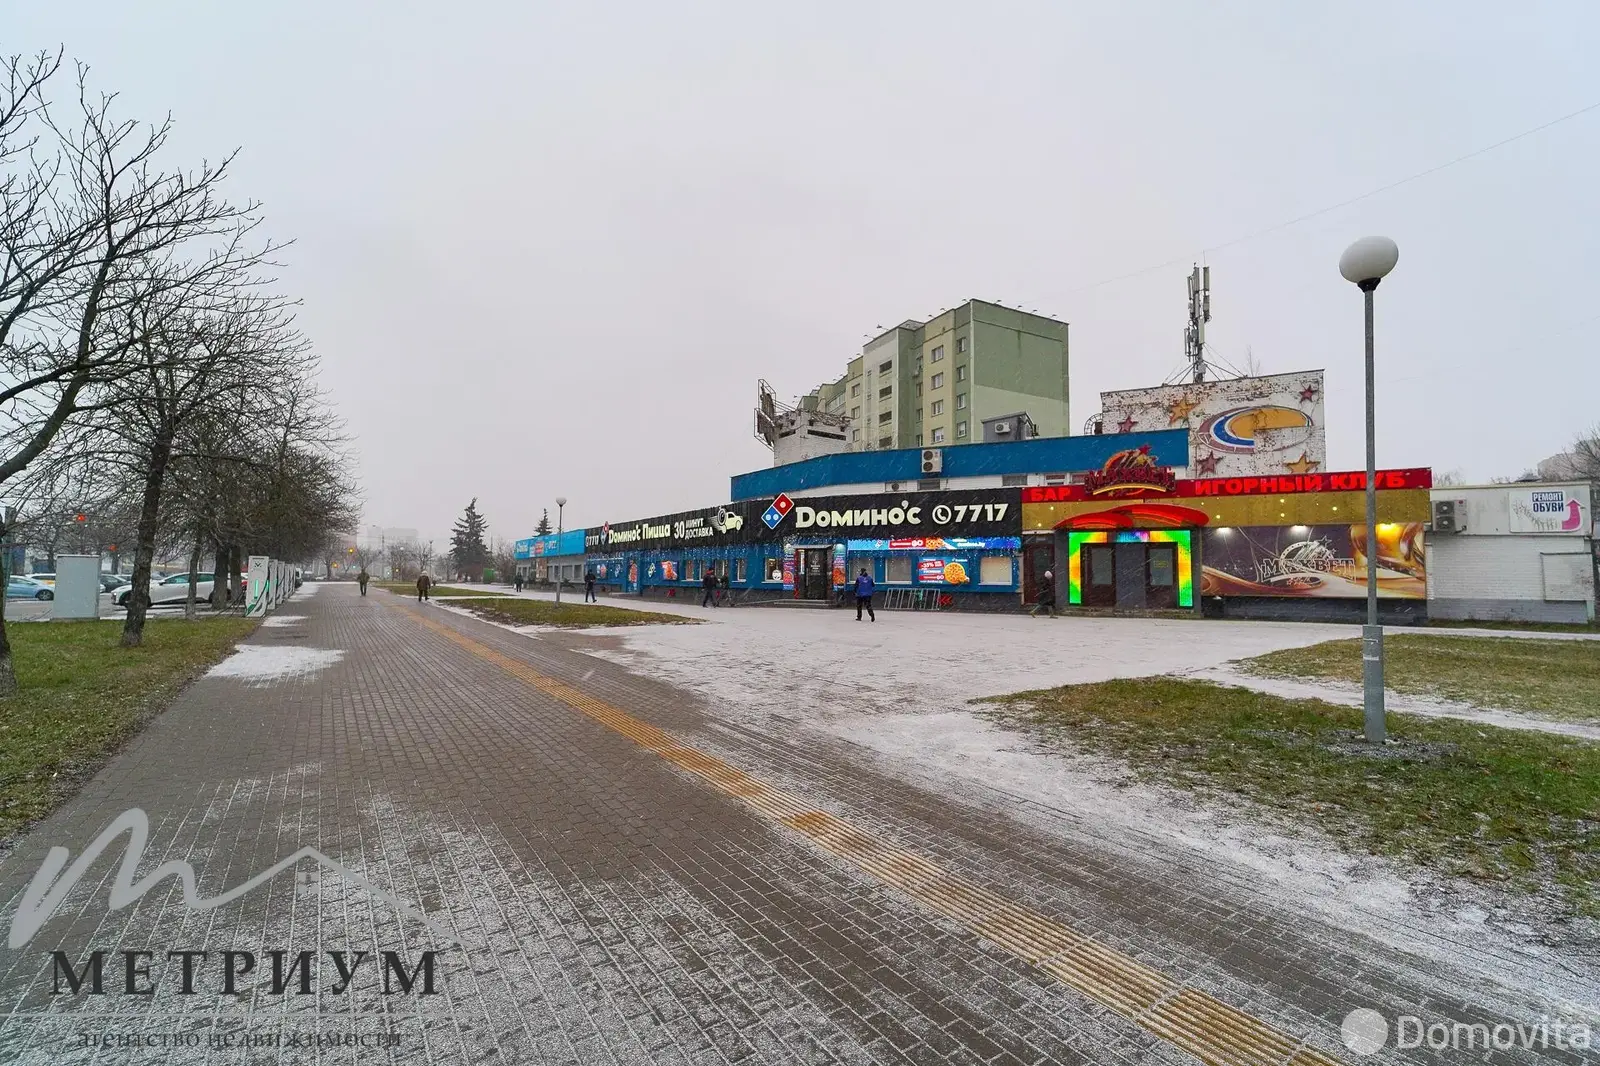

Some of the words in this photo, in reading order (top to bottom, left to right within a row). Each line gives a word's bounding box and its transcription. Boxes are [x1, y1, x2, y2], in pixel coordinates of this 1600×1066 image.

[1195, 474, 1322, 496] ИГОРНЫЙ
[1330, 471, 1406, 490] КЛУБ
[1031, 486, 1072, 502] БАР
[1533, 492, 1563, 502] РЕМОНТ
[954, 503, 1009, 523] 7717
[1533, 502, 1564, 512] ОБУВИ
[642, 523, 671, 540] Пицца
[674, 521, 685, 539] 30
[685, 526, 714, 539] ДОСТАВКА
